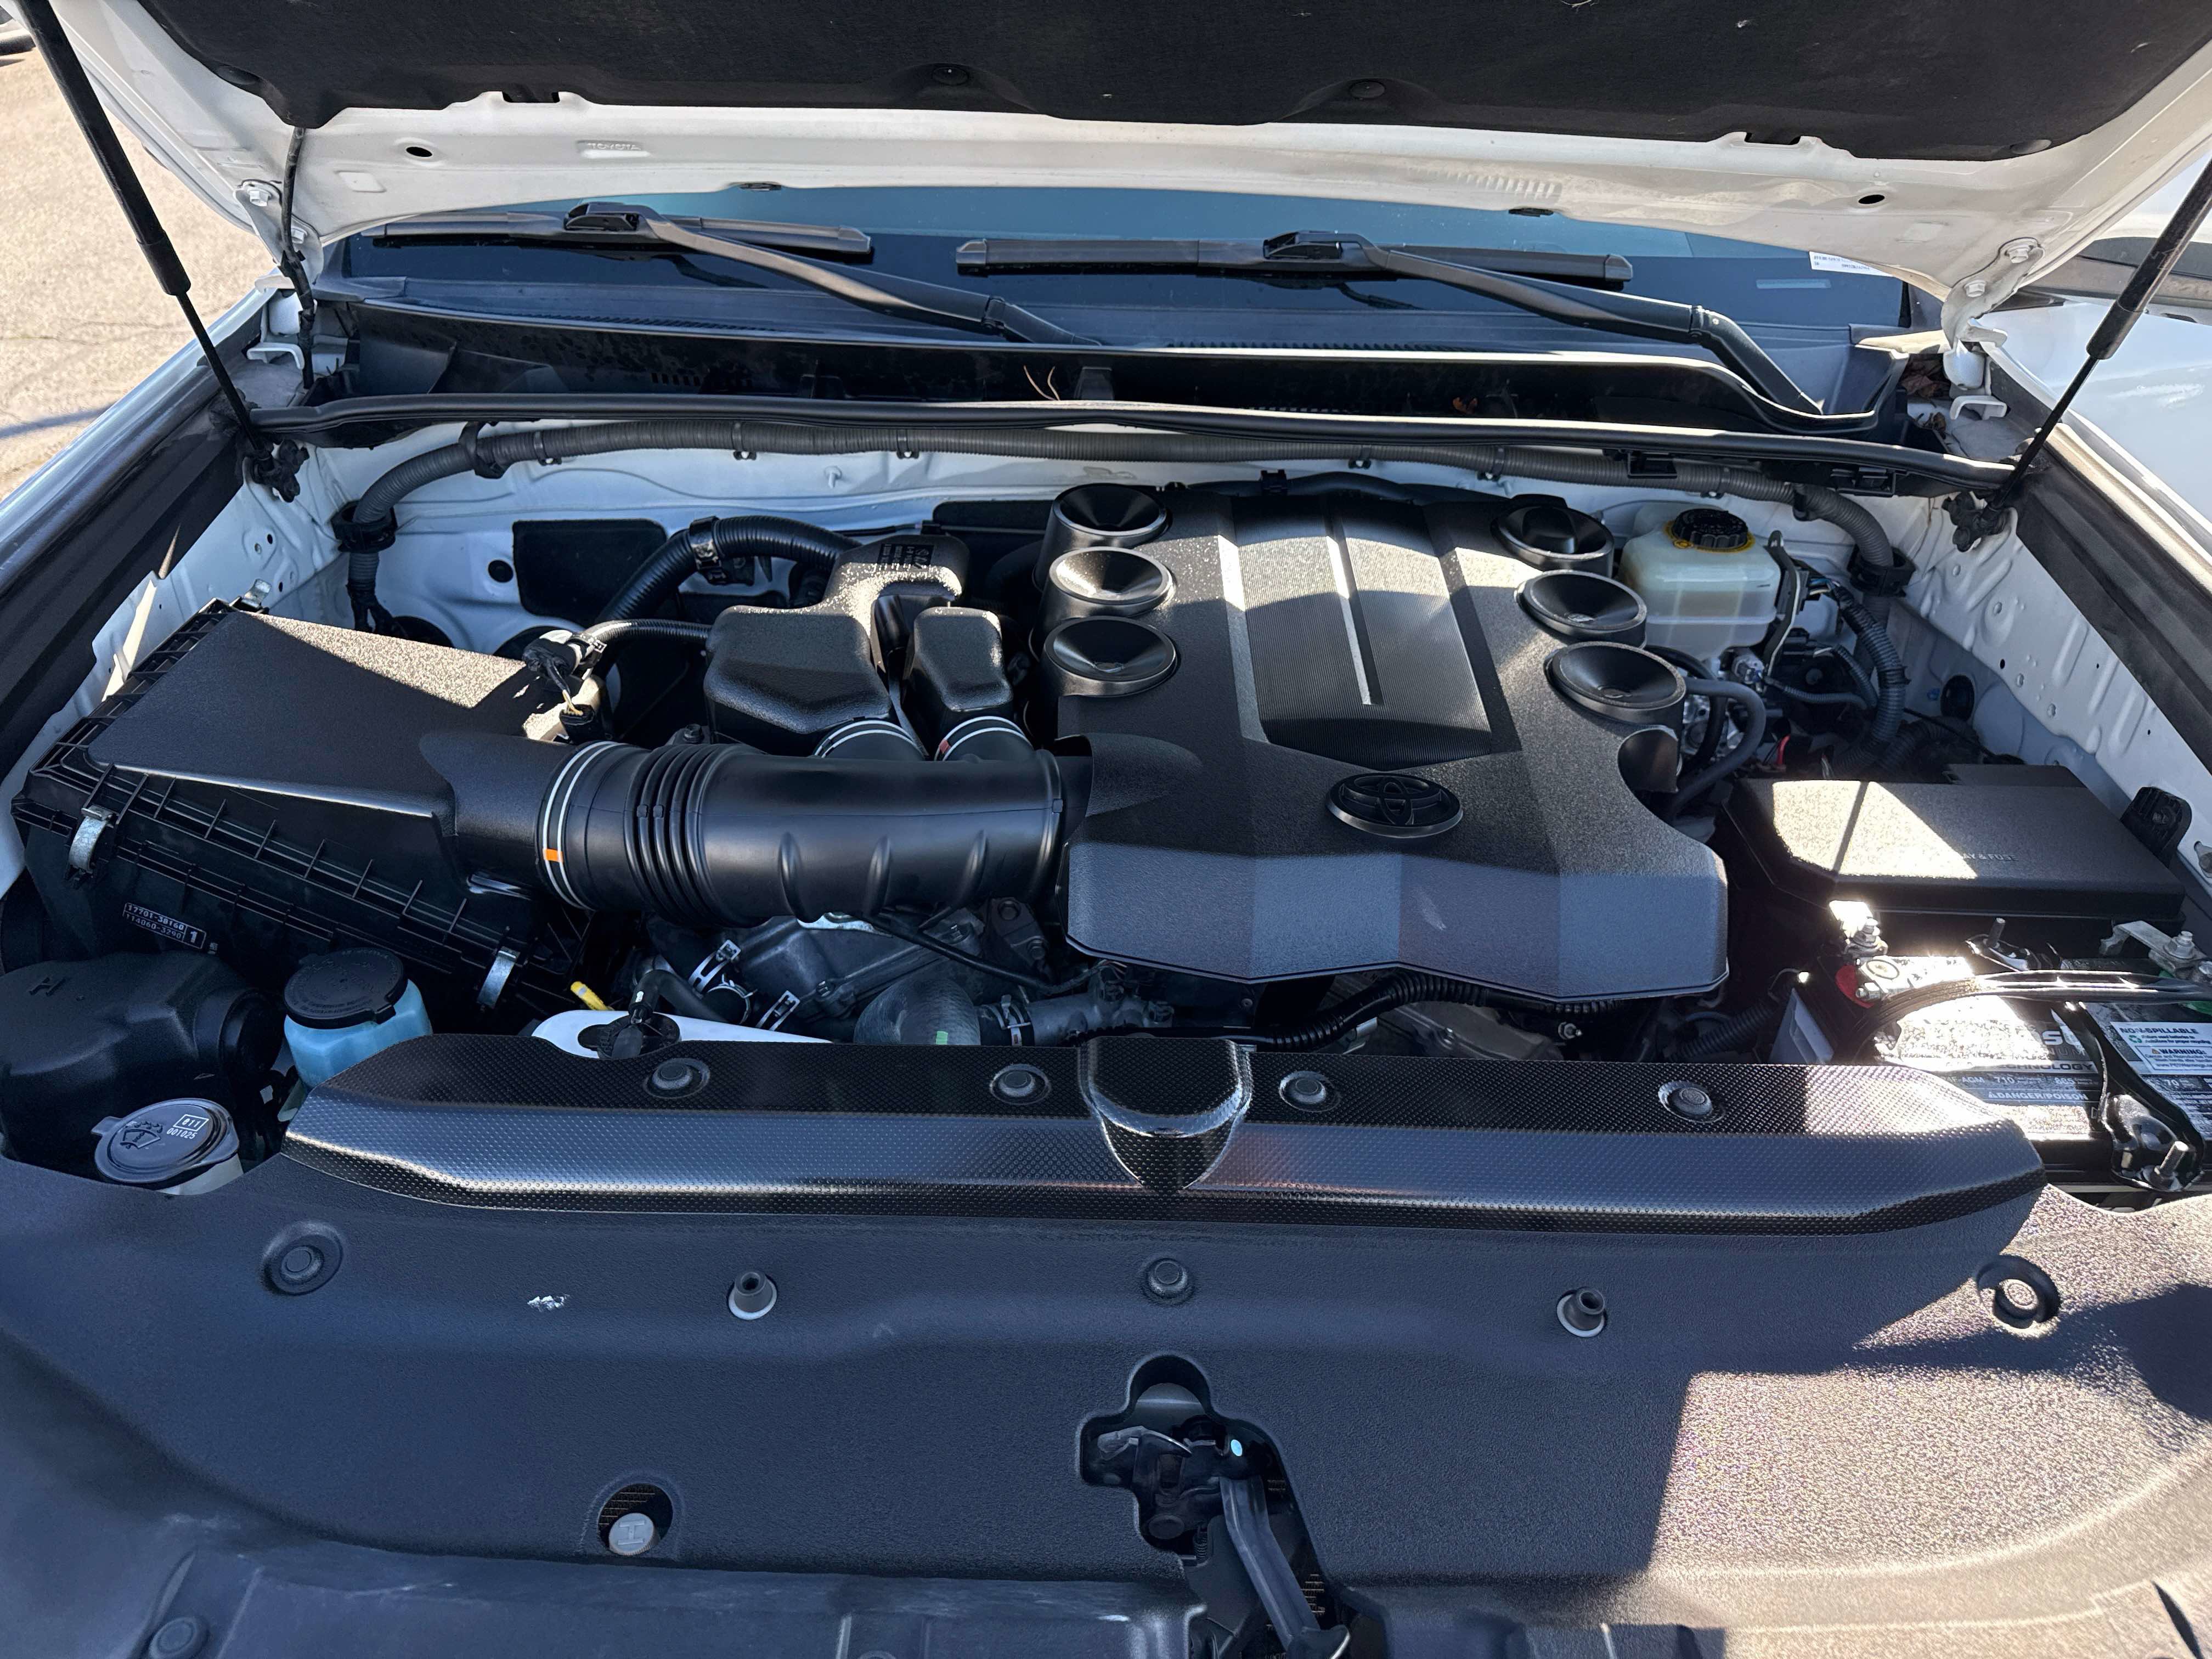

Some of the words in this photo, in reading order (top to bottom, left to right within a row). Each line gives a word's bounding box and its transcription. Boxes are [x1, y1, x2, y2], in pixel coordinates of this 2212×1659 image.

[190, 931, 198, 943] 1
[1997, 1091, 2089, 1101] DANGER/POISON
[167, 1127, 198, 1139] 001025
